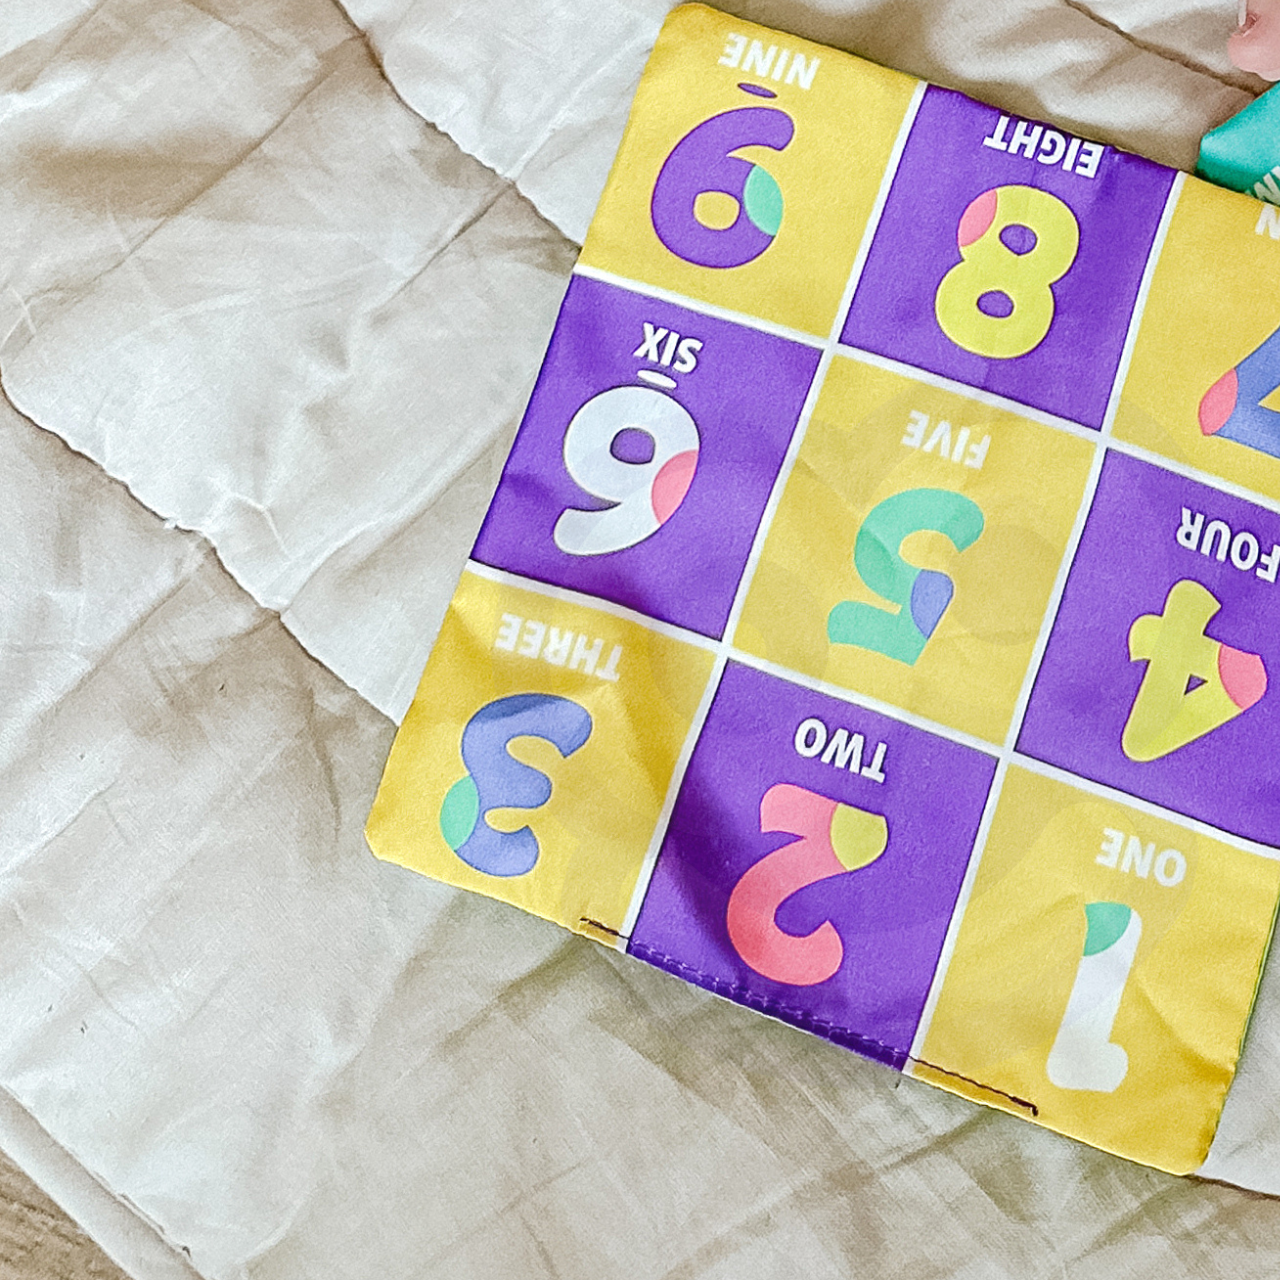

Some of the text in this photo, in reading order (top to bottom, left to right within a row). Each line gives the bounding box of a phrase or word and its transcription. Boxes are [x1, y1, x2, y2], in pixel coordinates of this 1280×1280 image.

[717, 32, 820, 90] NINE
[650, 106, 796, 269] 9
[983, 114, 1105, 179] EIGHT
[633, 322, 703, 374] SIX
[934, 184, 1081, 360] 8
[553, 384, 702, 557] 6
[902, 409, 992, 470] FIVE
[494, 611, 623, 683] THREE
[827, 487, 985, 667] 5
[794, 717, 888, 783] TWO
[1121, 579, 1268, 762] 4
[439, 692, 593, 878] 3
[1095, 828, 1187, 887] ONE
[726, 783, 889, 986] 2
[1046, 901, 1142, 1093] 1
